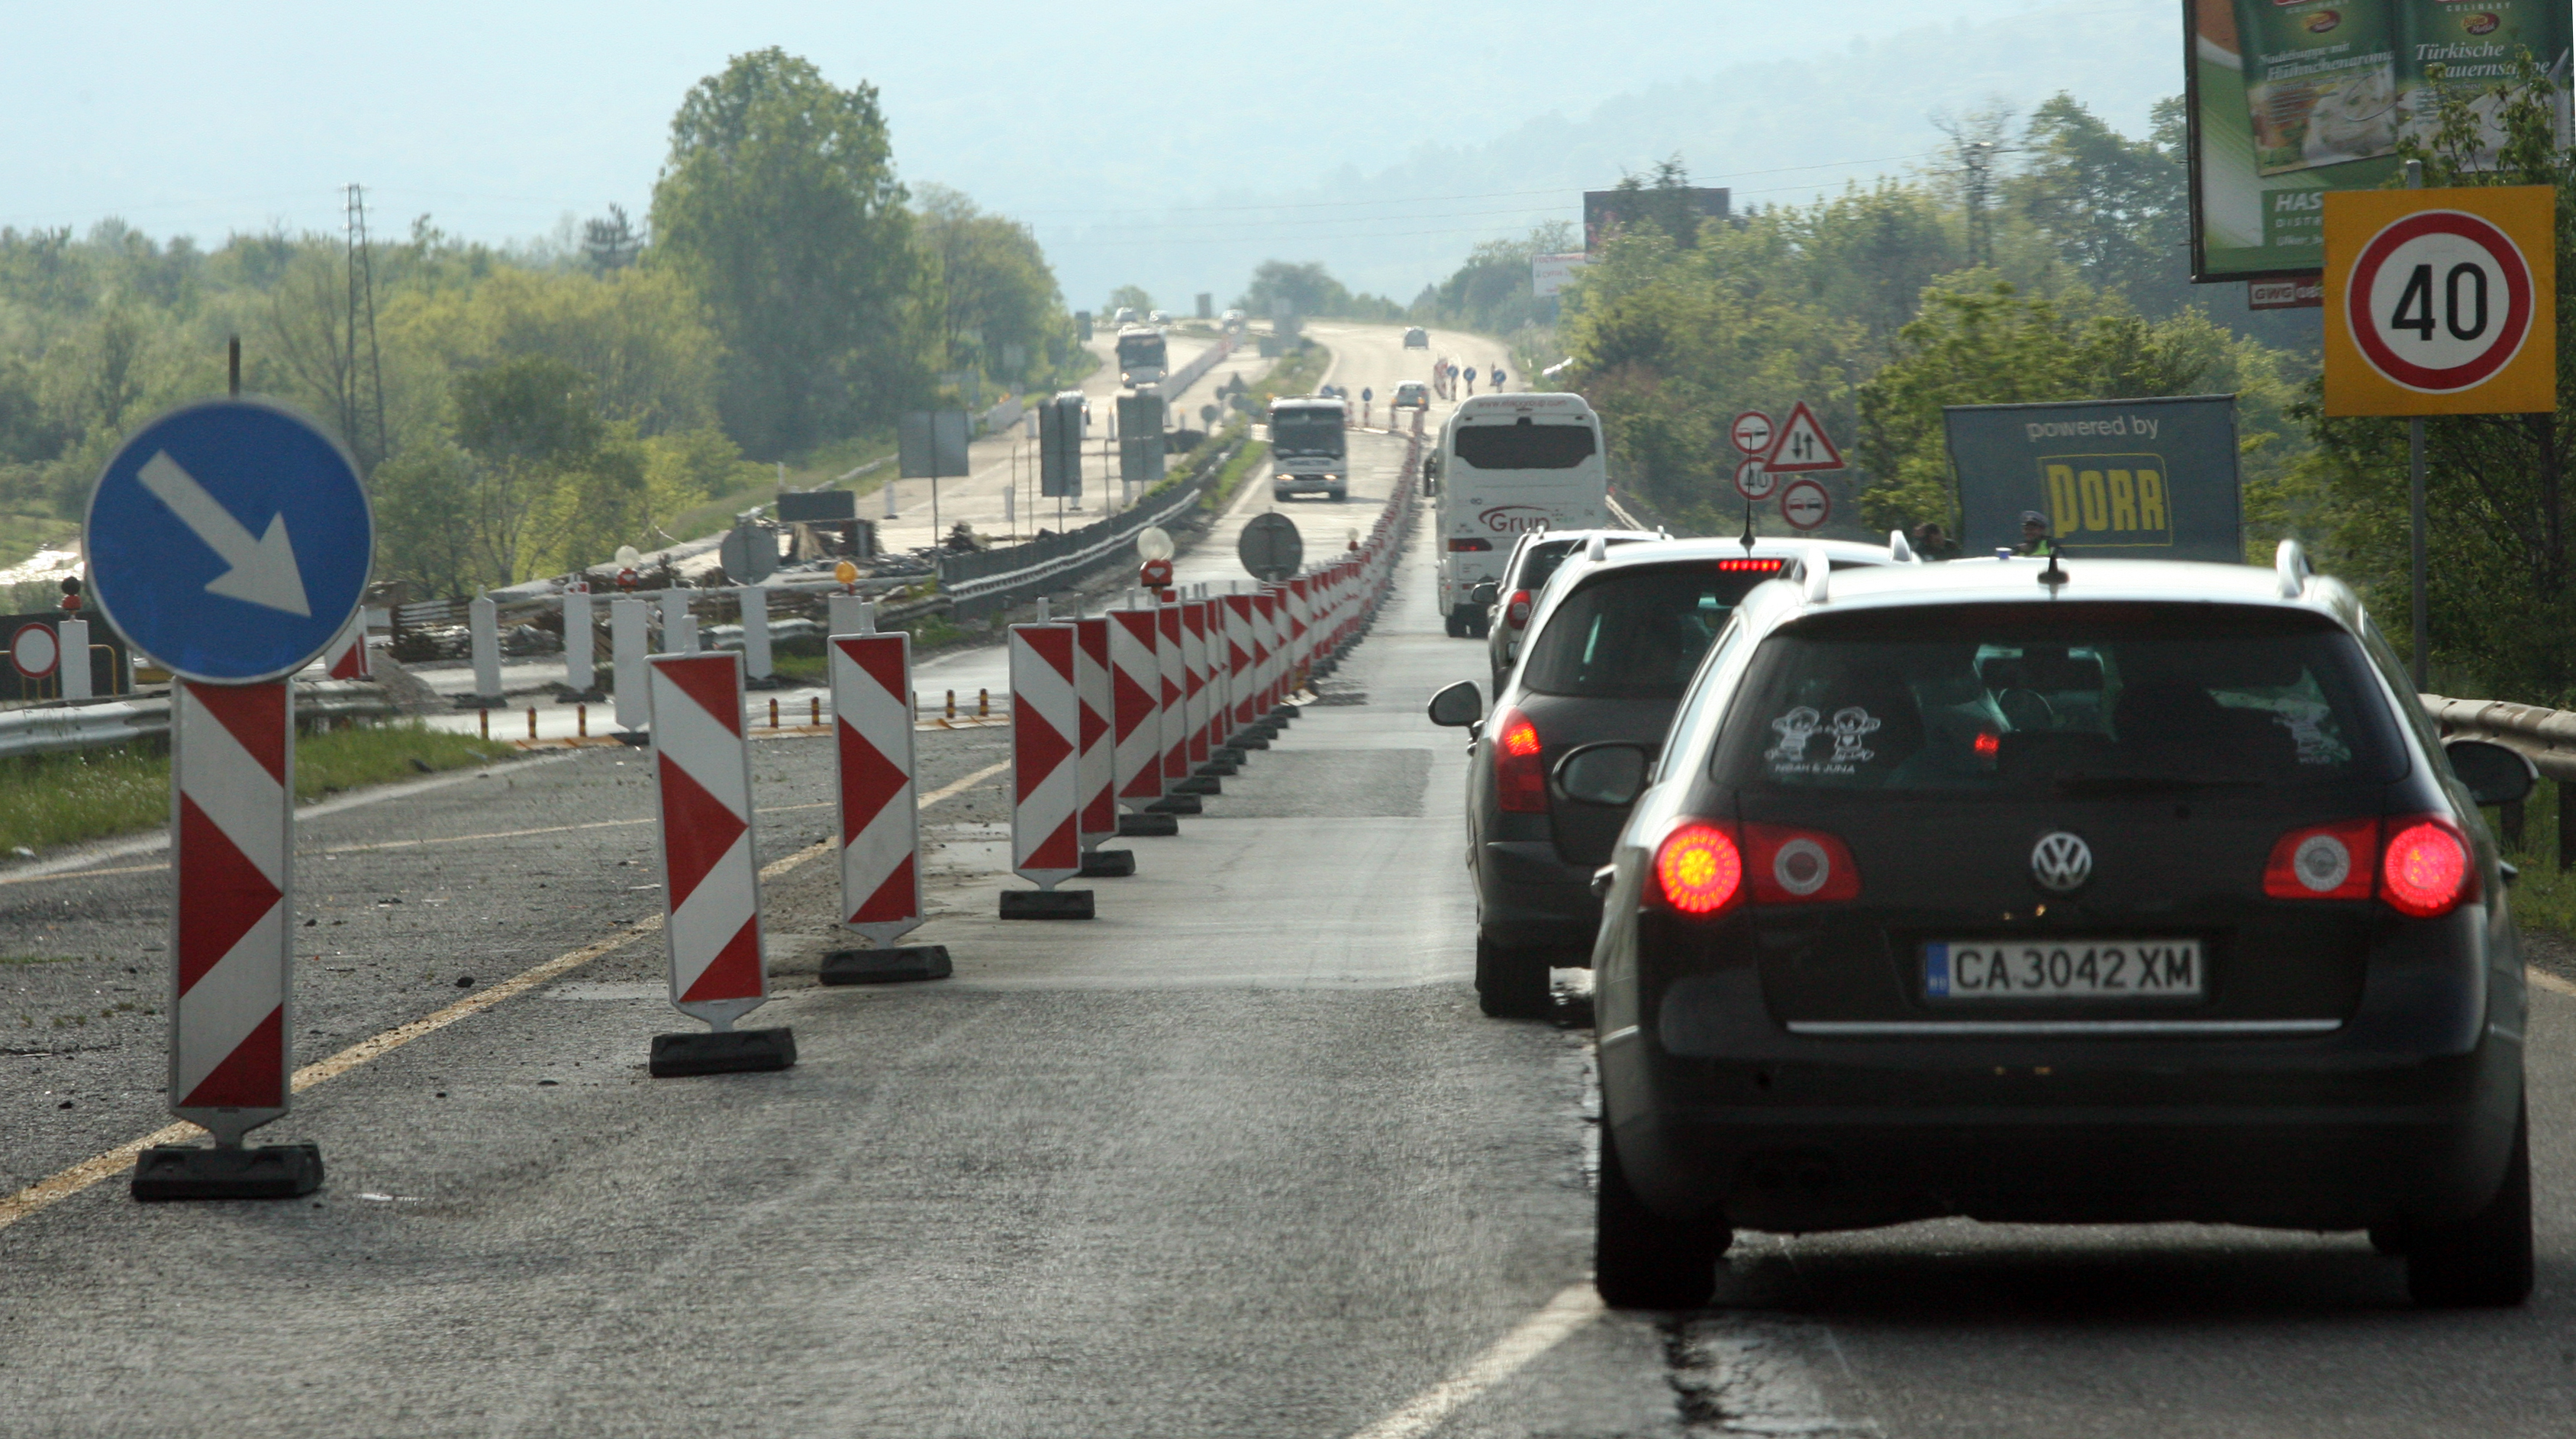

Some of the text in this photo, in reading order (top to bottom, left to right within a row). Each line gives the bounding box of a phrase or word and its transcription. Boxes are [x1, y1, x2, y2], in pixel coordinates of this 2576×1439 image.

[2416, 41, 2506, 61] Türkische
[2392, 263, 2487, 340] 40
[2026, 415, 2159, 442] powered by
[2046, 465, 2165, 538] PORR
[1489, 513, 1550, 532] Grup
[1956, 947, 2193, 990] CA 3042 XM
